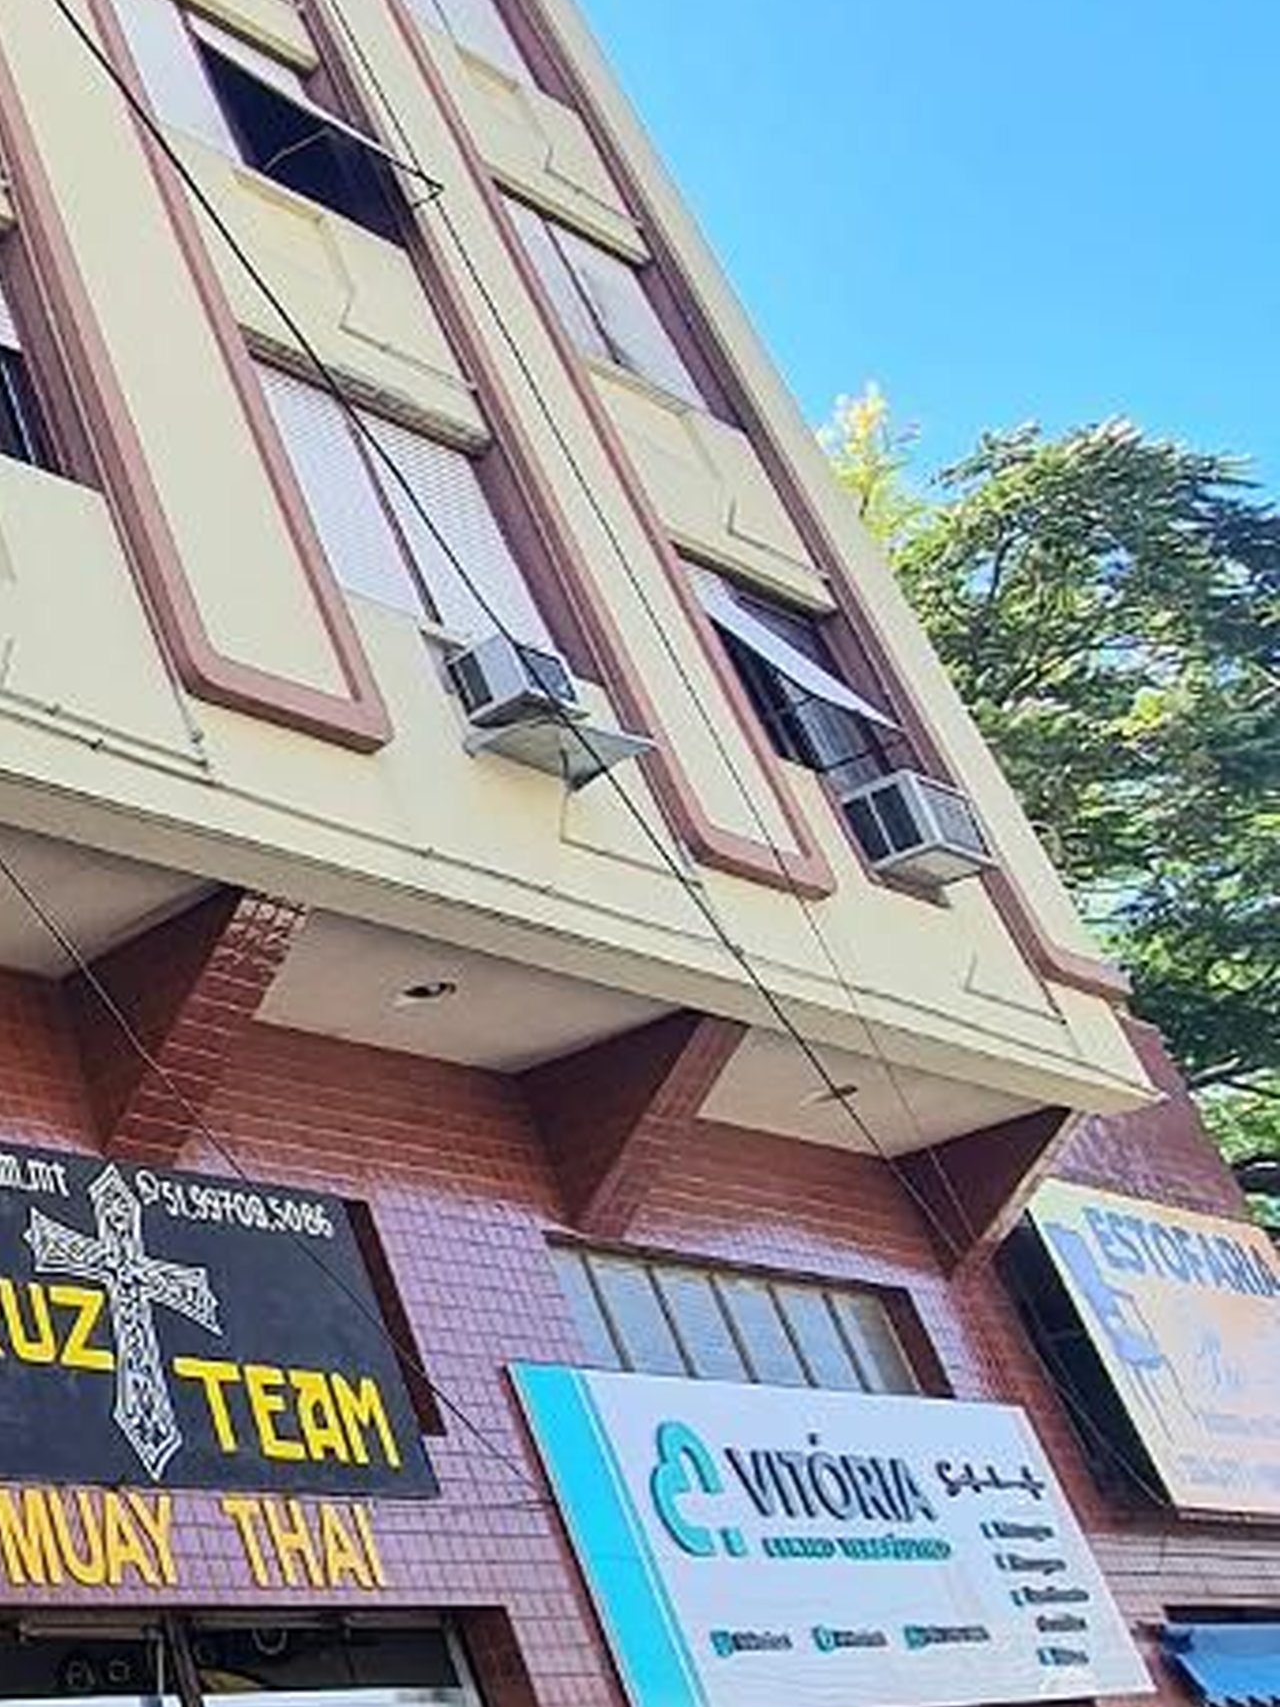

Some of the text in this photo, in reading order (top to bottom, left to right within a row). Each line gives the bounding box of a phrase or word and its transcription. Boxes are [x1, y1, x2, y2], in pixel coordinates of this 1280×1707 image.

[172, 1355, 402, 1470] TEAM
[724, 1432, 937, 1523] VITÓRIA
[223, 1495, 387, 1589] THAI
